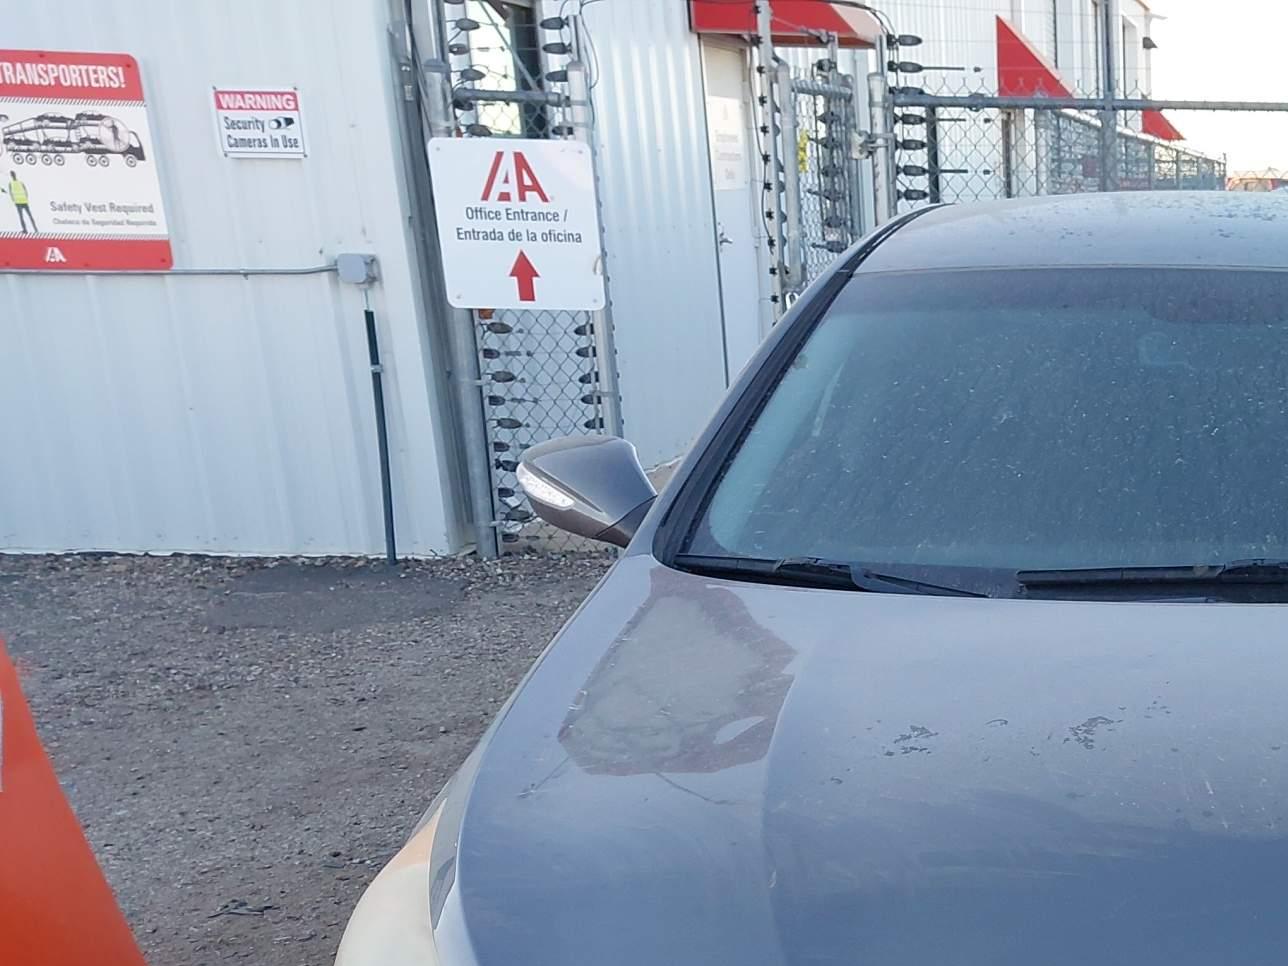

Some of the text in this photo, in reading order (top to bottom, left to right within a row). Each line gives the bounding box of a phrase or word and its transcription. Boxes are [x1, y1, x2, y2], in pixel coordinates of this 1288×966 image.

[219, 93, 296, 109] WARNING
[224, 116, 265, 133] Security
[227, 134, 299, 148] Cameras In Use
[50, 201, 154, 215] Safety Vest Required
[465, 206, 502, 221] Office
[505, 208, 560, 222] Entrance
[456, 227, 582, 243] Entrada de la oficina
